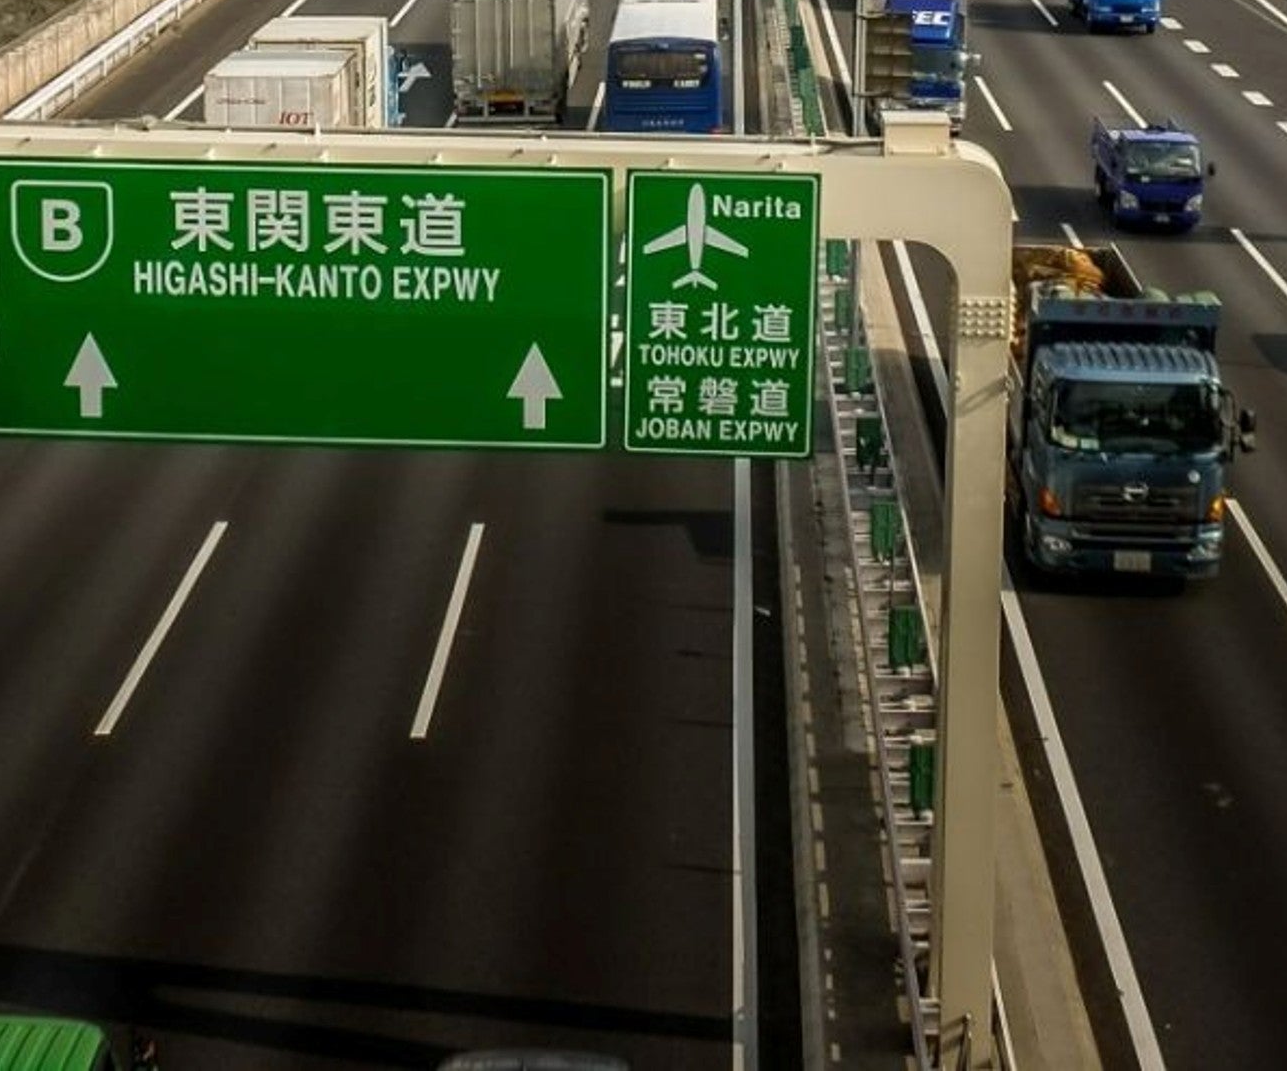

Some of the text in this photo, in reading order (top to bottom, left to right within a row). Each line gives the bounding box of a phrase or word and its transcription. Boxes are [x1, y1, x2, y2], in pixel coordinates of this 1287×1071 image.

[42, 199, 82, 251] B
[170, 187, 465, 256] 東関東道
[713, 195, 800, 218] Narita
[134, 261, 499, 301] HIGASHI-KANTO EXPWY
[649, 301, 792, 342] 東北道
[640, 345, 798, 367] TOHOKU EXPWY
[636, 418, 797, 440] JOBAN EXPWY
